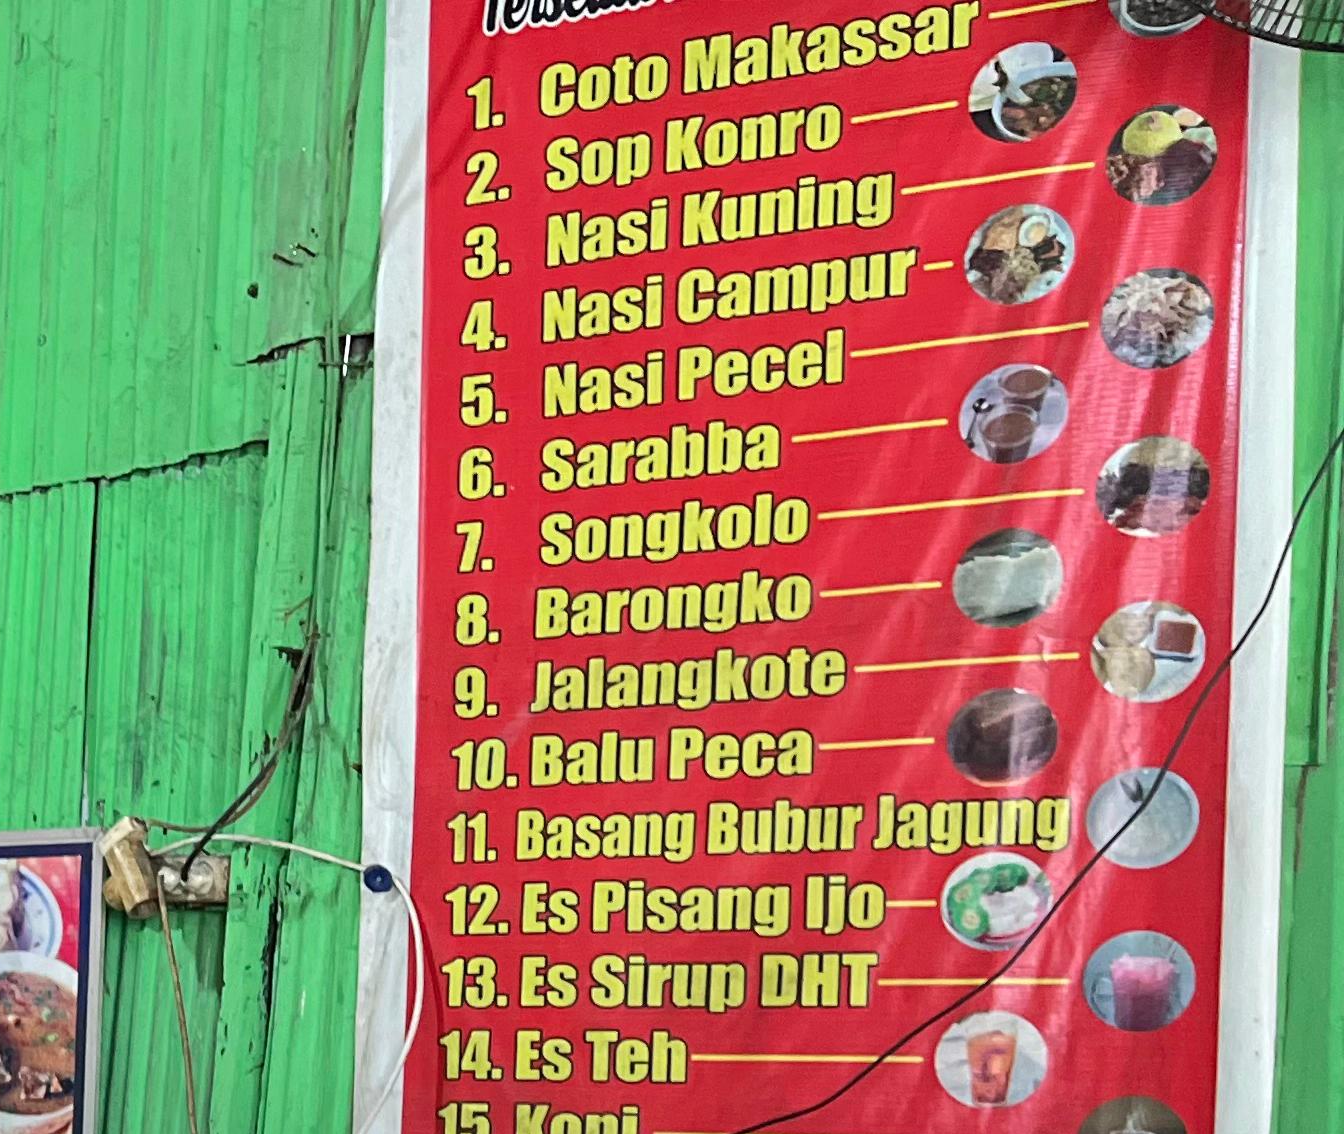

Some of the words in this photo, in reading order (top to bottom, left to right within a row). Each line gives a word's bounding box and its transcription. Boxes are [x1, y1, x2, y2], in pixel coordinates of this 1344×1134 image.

[465, 76, 505, 131] 1.
[538, 53, 670, 118] Coto
[683, 0, 982, 95] Makassar
[465, 151, 511, 206] 2.
[544, 134, 650, 193] Sop
[665, 102, 843, 169] Konro
[462, 224, 512, 280] 3.
[546, 195, 668, 269] Nasi
[682, 172, 895, 246] Kuning
[460, 299, 509, 352] 4.
[543, 272, 662, 343] Nasi
[676, 246, 919, 325] Campur
[460, 374, 509, 428] 5.
[543, 352, 663, 418] Nasi
[678, 328, 847, 401] Pecel
[457, 447, 507, 500] 6.
[541, 420, 782, 493] Sarabba
[456, 522, 495, 573] 7.
[540, 492, 811, 566] Songkolo
[455, 594, 500, 646] 8.
[534, 569, 813, 640] Barongko
[455, 667, 499, 718] 9.
[530, 646, 847, 715] Jalangkote
[451, 738, 517, 791] 10.
[529, 732, 654, 786] Balu
[669, 729, 814, 781] Peca
[448, 813, 498, 864] 11.
[515, 805, 695, 862] Basang
[706, 800, 864, 857] Bubur
[873, 795, 1070, 853] Jagung
[445, 886, 510, 936] 12.
[520, 881, 580, 935] Es
[592, 881, 790, 938] Pisang
[805, 879, 887, 935] Ijo
[441, 958, 509, 1009] 13.
[519, 957, 578, 1008] Es
[590, 954, 751, 1013] Sirup
[761, 952, 879, 1008] DHT
[440, 1030, 504, 1083] 14.
[515, 1029, 572, 1082] Es
[583, 1029, 690, 1084] Teh
